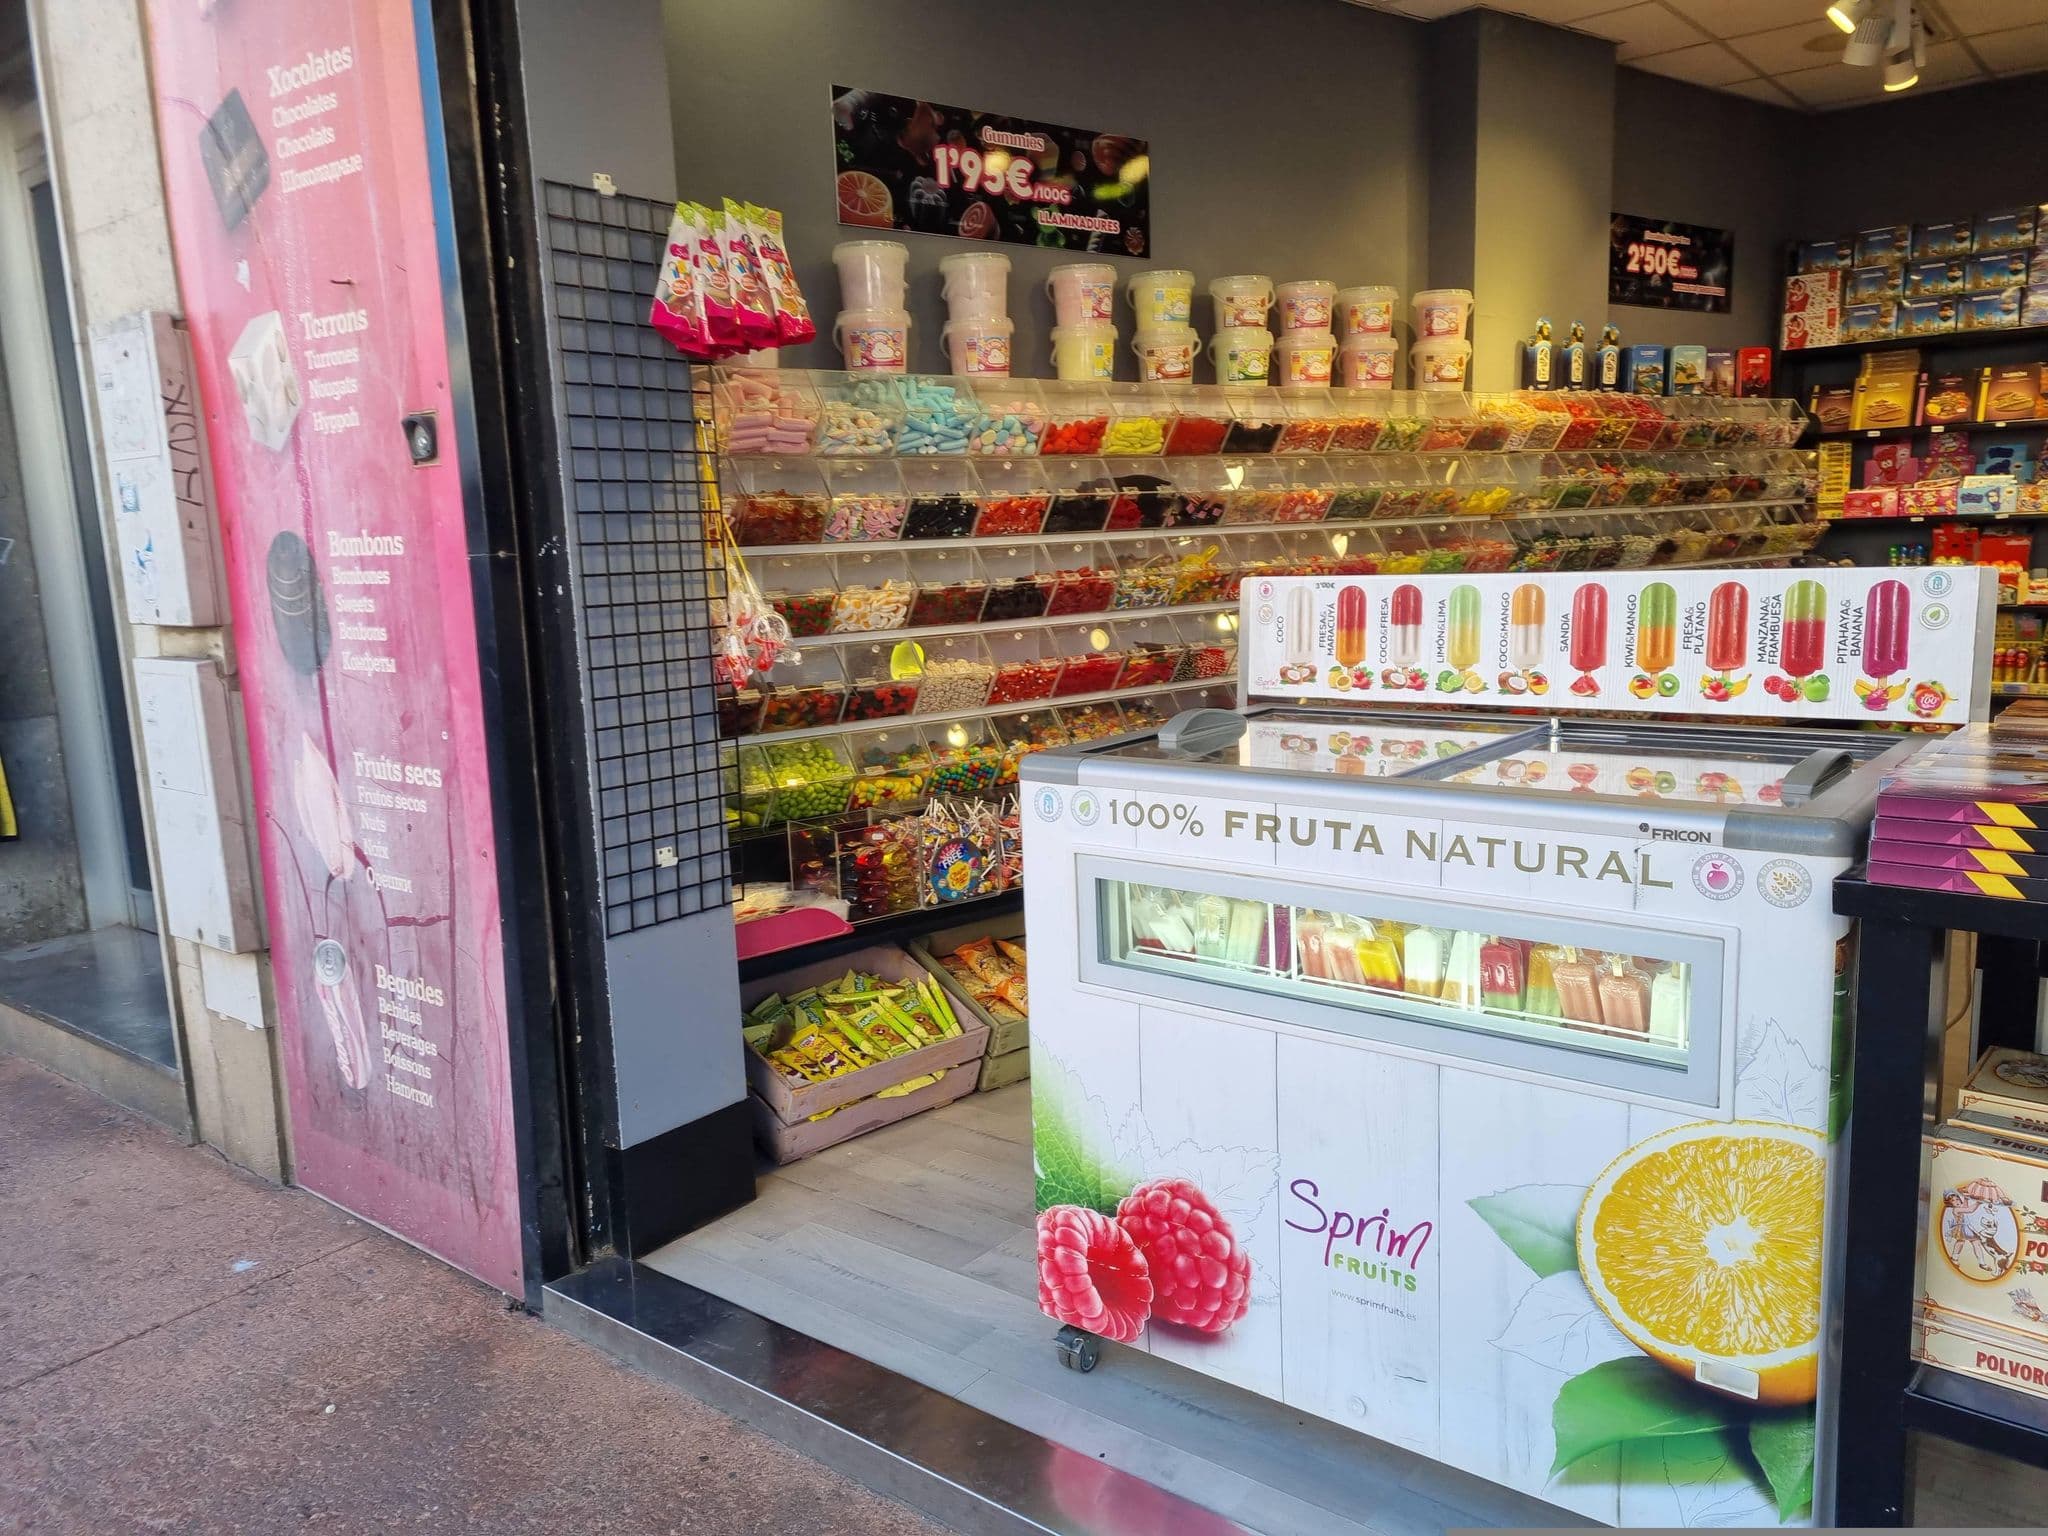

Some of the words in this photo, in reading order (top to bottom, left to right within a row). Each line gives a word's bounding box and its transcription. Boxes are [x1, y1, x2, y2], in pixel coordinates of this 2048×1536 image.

[266, 45, 353, 98] Xocolates
[982, 126, 1045, 152] Gummies
[1038, 210, 1121, 234] LLAMINADURES
[327, 529, 405, 557] Bombons
[1276, 615, 1284, 643] COCO
[1380, 597, 1389, 664] COCO&FRESA
[1437, 598, 1447, 663] LIMÓN&LIMA
[1499, 592, 1510, 669] COCO&MANGO
[1624, 594, 1637, 668] KIWI&MANGO
[1683, 606, 1694, 650] FRESA&
[1757, 596, 1770, 663] MANZANA&
[1768, 593, 1782, 665] FRAMBUESA
[1836, 599, 1850, 664] PITAHAYA&
[1850, 606, 1864, 657] BANANA
[352, 751, 402, 782] Fruits
[404, 764, 442, 788] secs
[1109, 799, 1204, 837] 100%
[1224, 810, 1385, 856] FRUTA
[1405, 829, 1674, 889] NATURAL
[1652, 828, 1711, 843] FRICON
[375, 964, 444, 1007] Begudes
[378, 997, 422, 1026] Bebidas
[380, 1021, 437, 1056] Beverages
[382, 1047, 432, 1079] Boissons
[1285, 1179, 1432, 1270] Sprim
[1331, 1288, 1417, 1321] www.sprimfruits.es
[1976, 1351, 2048, 1387] POLVOR
